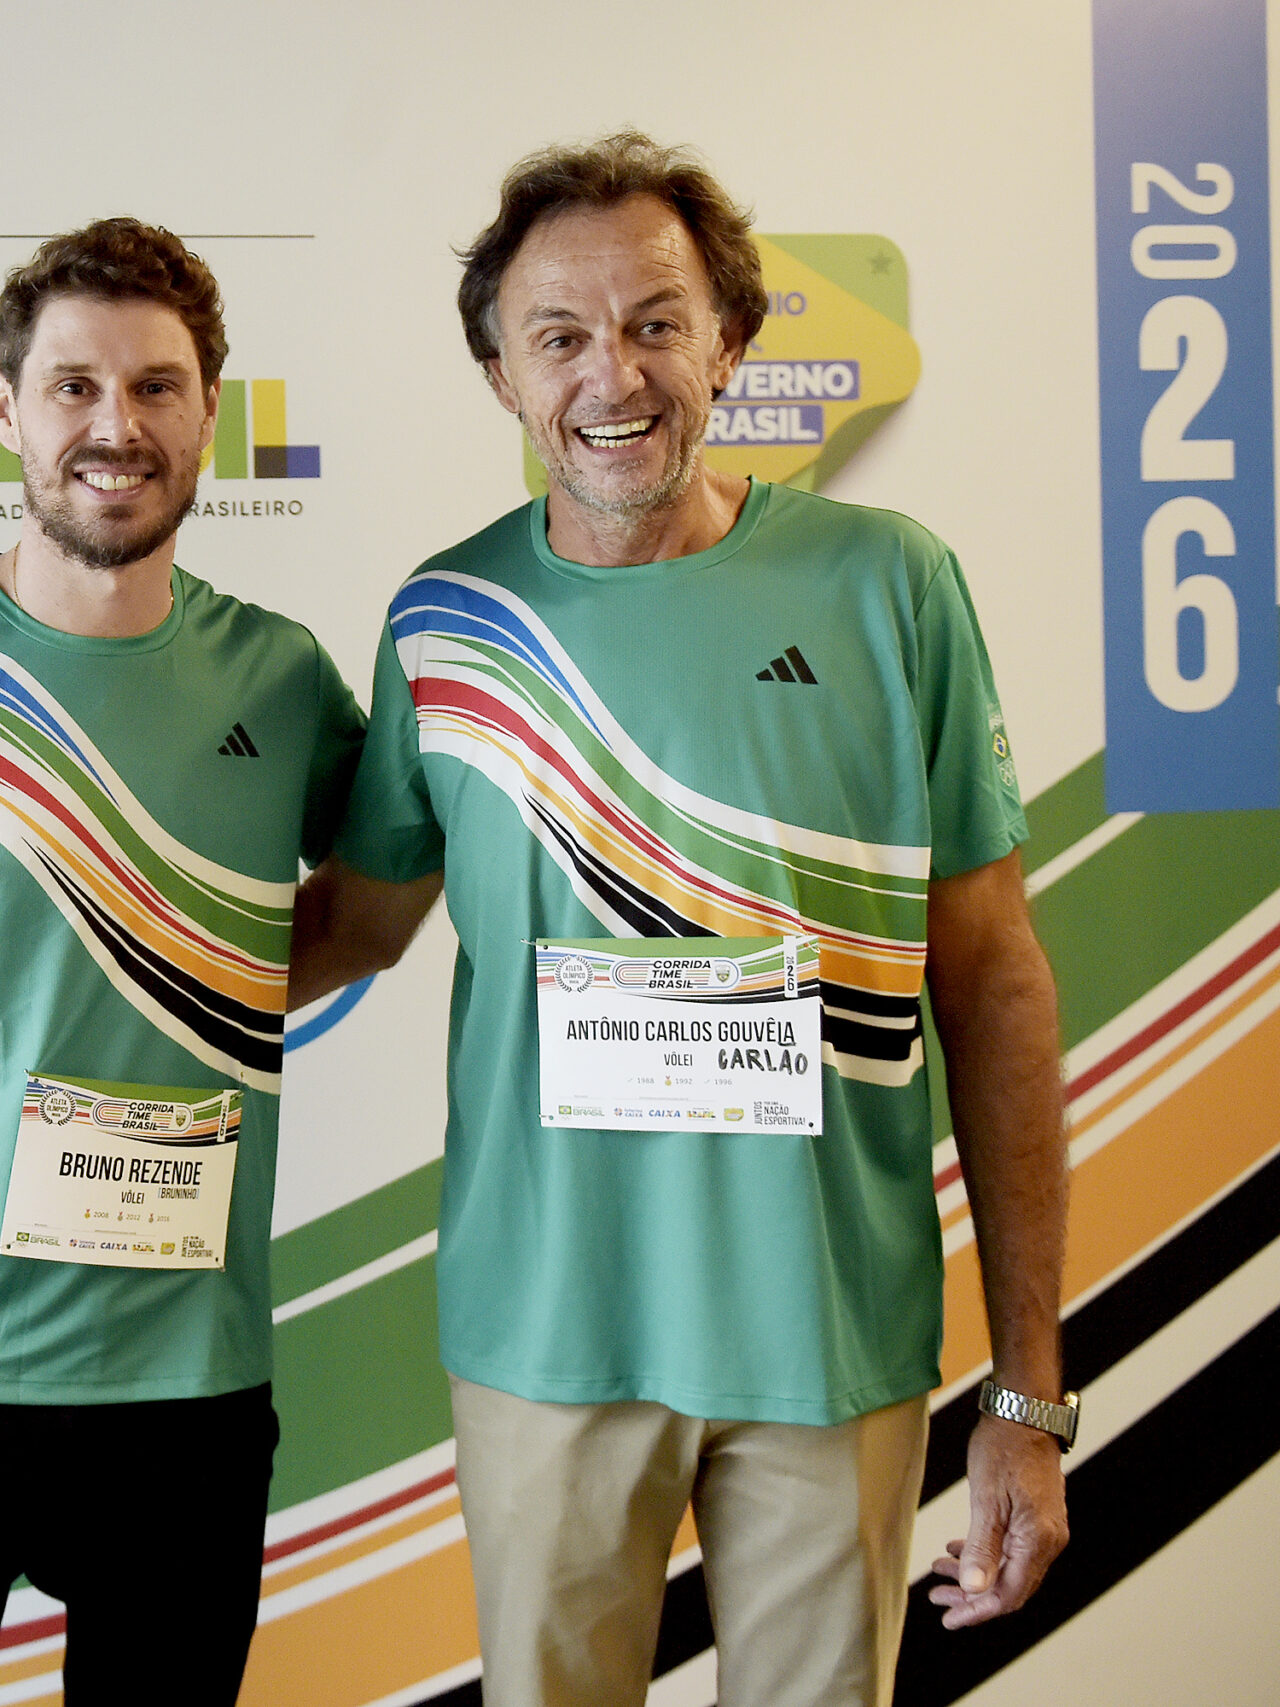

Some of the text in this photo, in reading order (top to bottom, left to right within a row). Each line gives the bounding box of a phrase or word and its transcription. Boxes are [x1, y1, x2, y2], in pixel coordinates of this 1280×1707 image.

[725, 364, 854, 397] VERNO
[704, 407, 820, 441] RASIL
[187, 500, 303, 517] RASILEIRO
[653, 960, 711, 969] CORRIDA
[652, 969, 682, 979] TIME
[648, 979, 694, 989] BRASIL
[566, 1016, 639, 1041] ANTÔNIO
[645, 1020, 712, 1042] CARLOS
[663, 1051, 693, 1066] VÔLEI
[129, 1102, 174, 1113] CORRIDA
[127, 1111, 152, 1121] TIME
[648, 1109, 681, 1118] CAIXA
[121, 1120, 158, 1131] BRASIL
[59, 1151, 203, 1186] BRUNO REZENDE
[121, 1190, 145, 1204] VÔLEI
[100, 1242, 128, 1251] CAIXA
